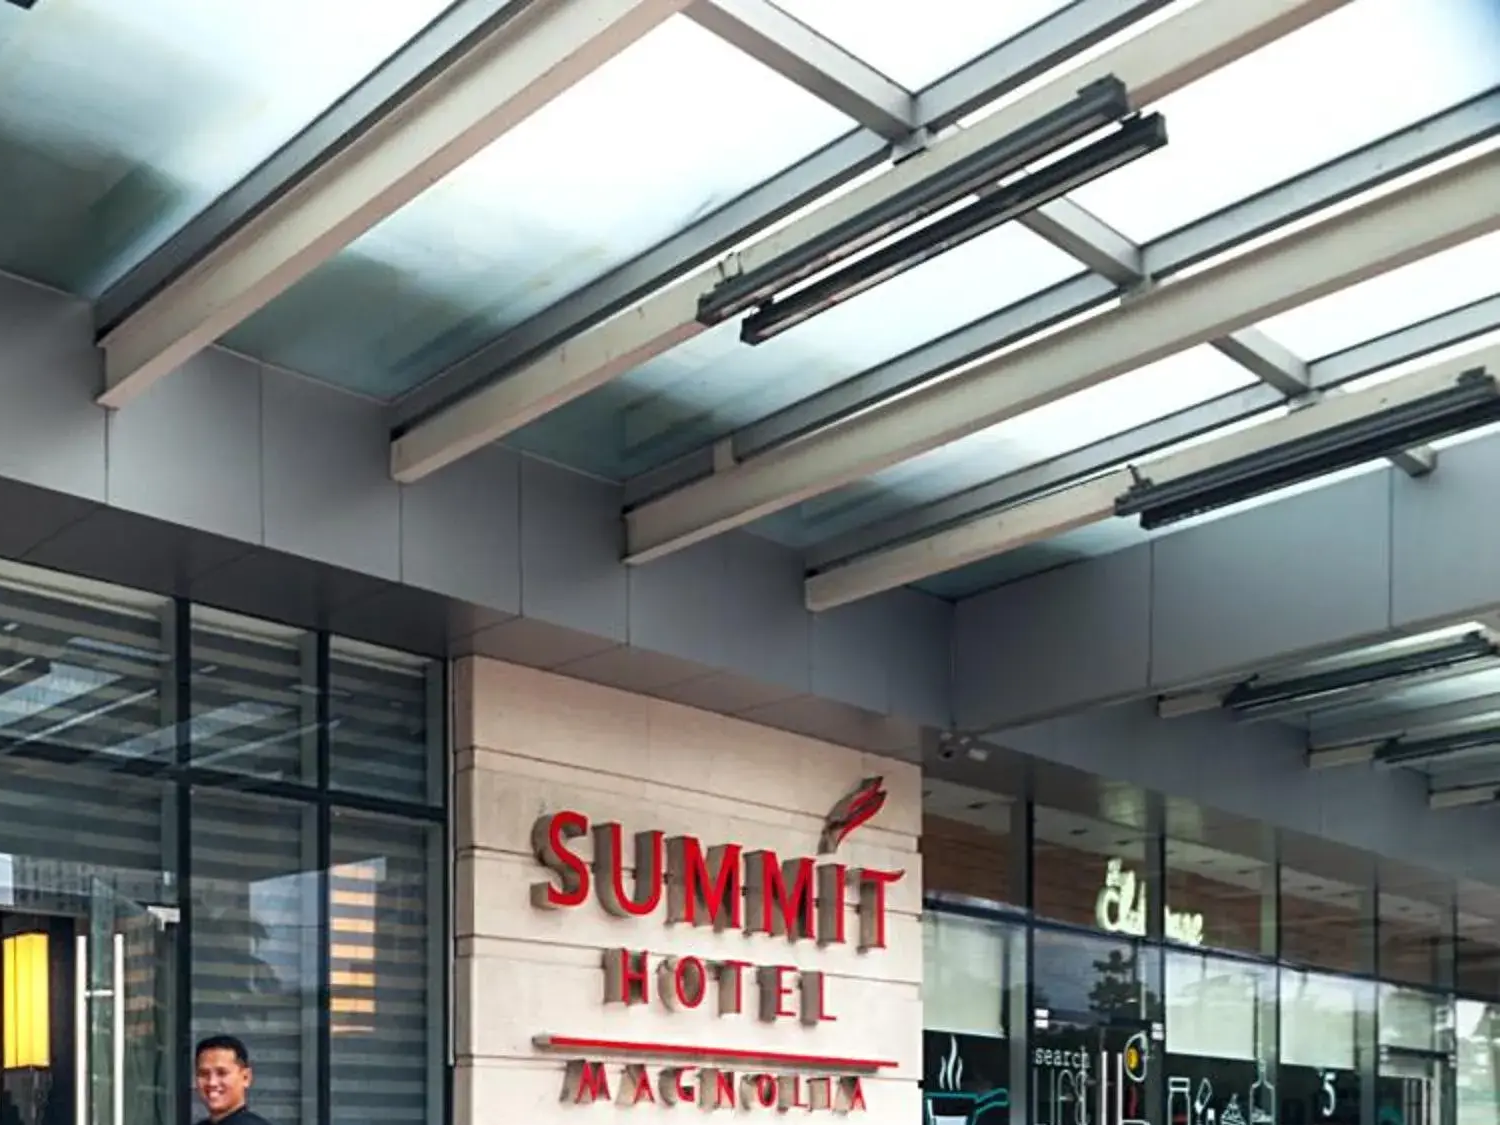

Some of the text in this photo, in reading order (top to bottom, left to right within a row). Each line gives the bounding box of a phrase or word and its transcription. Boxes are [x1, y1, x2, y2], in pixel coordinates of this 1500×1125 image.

[531, 811, 906, 953] SUMMIT
[603, 948, 837, 1026] HOTEL
[560, 1060, 867, 1115] MAGNOLIA
[1034, 1047, 1091, 1068] search
